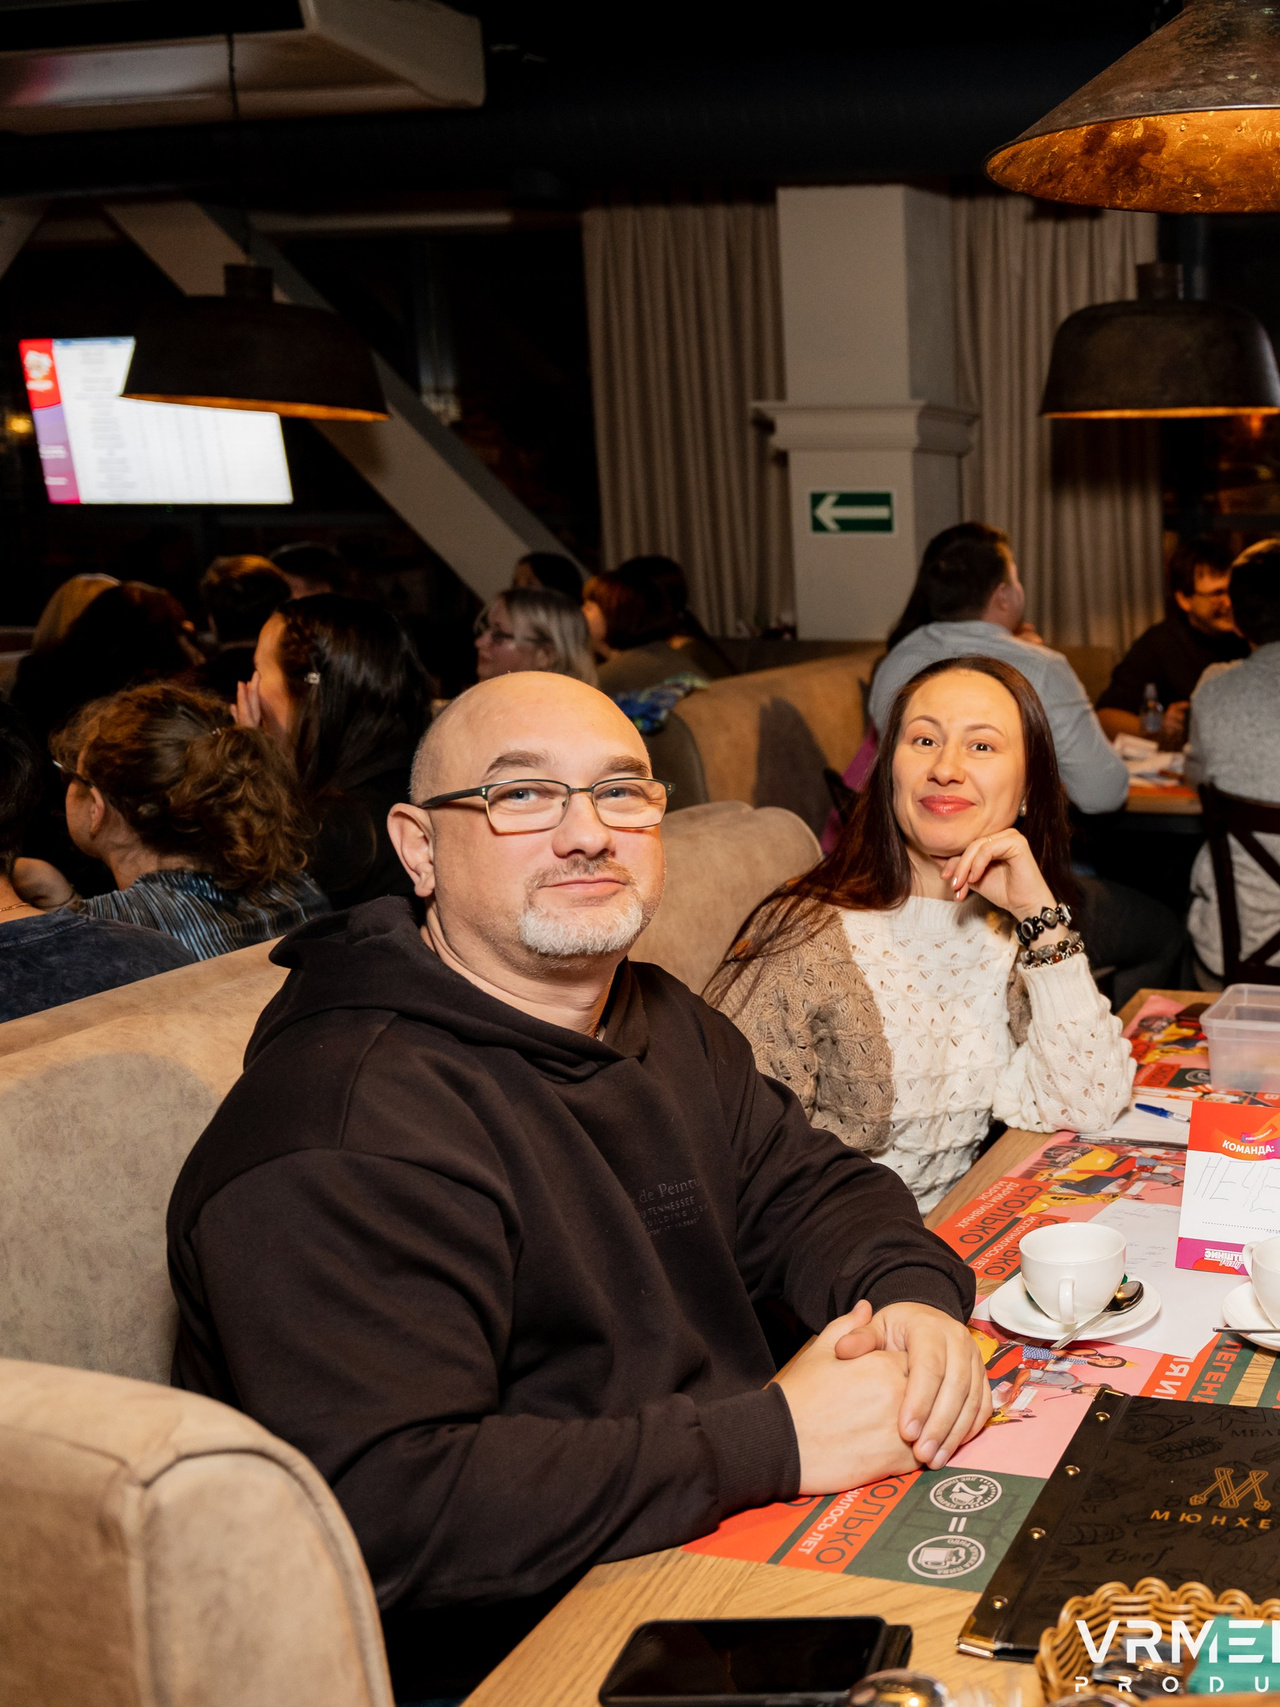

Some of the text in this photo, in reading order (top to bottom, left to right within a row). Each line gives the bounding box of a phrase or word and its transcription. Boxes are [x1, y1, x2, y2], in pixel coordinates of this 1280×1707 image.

[1222, 1140, 1275, 1156] КОМАНДА:
[976, 1180, 1008, 1201] МАРОК
[988, 1181, 1020, 1204] ДАРИМ
[647, 1195, 696, 1216] TENNESSEE
[958, 1185, 1043, 1244] СТОЛЬКО
[972, 1257, 990, 1270] ЛЕТ
[816, 1474, 908, 1564] ОЛЬКО
[817, 1488, 865, 1531] НИЛОСЬ
[797, 1531, 825, 1555] ЛЕТ
